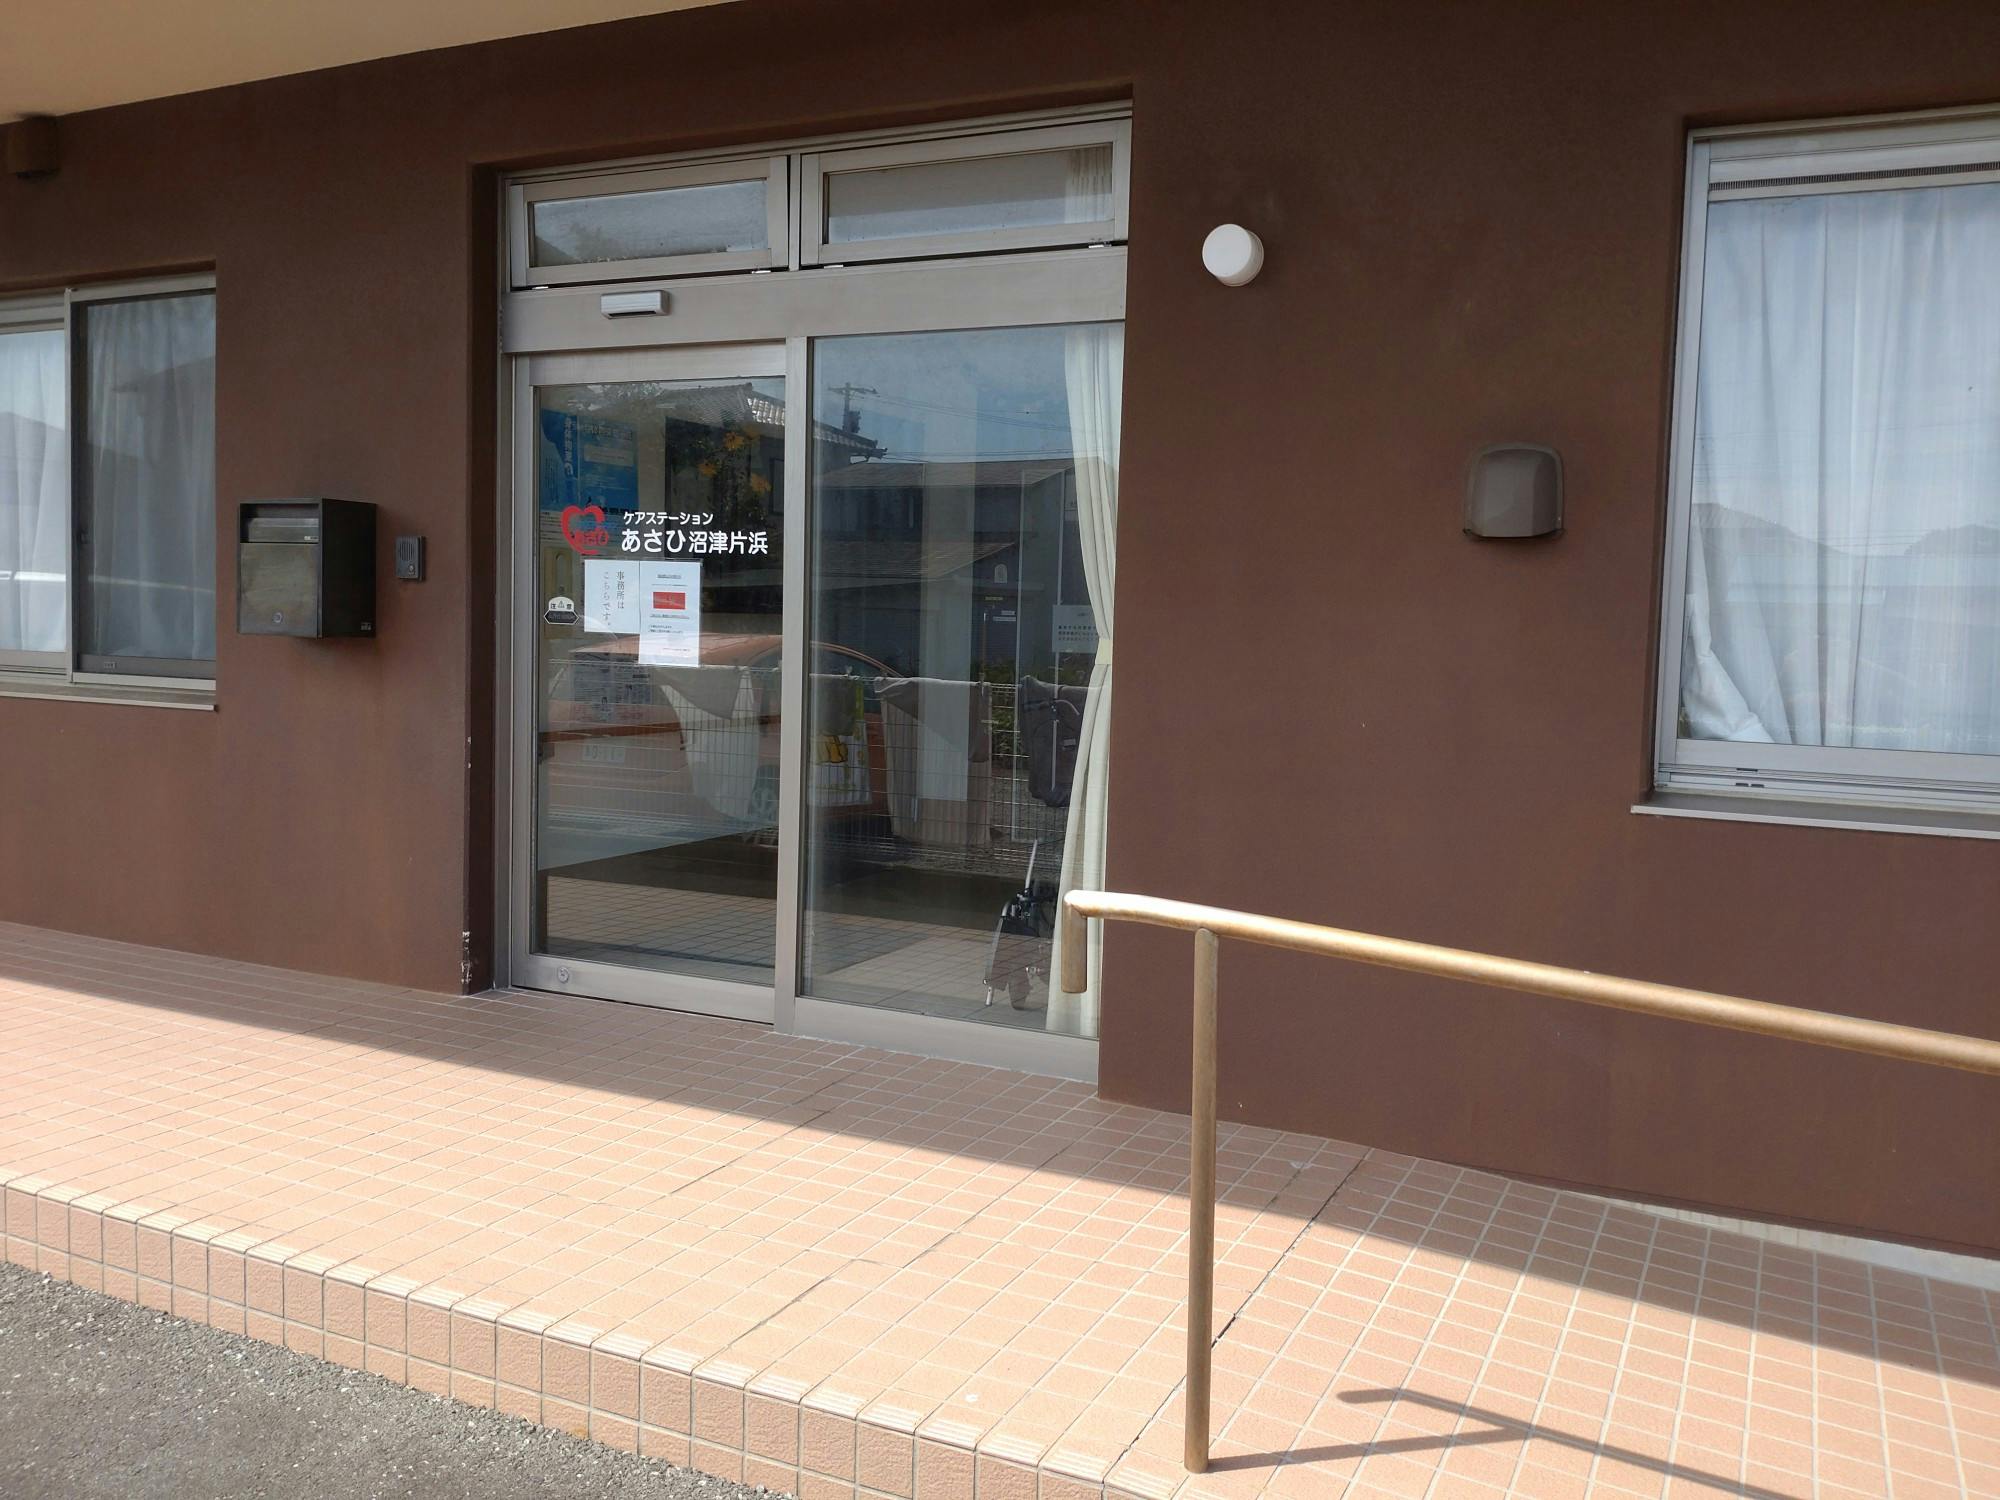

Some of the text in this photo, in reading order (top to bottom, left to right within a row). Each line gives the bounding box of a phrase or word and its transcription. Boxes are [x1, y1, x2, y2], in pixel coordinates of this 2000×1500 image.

[623, 511, 714, 526] ケアステーション
[621, 528, 768, 555] あさひ沼津片浜
[601, 571, 611, 626] こちらです。
[616, 570, 625, 609] 事務所は
